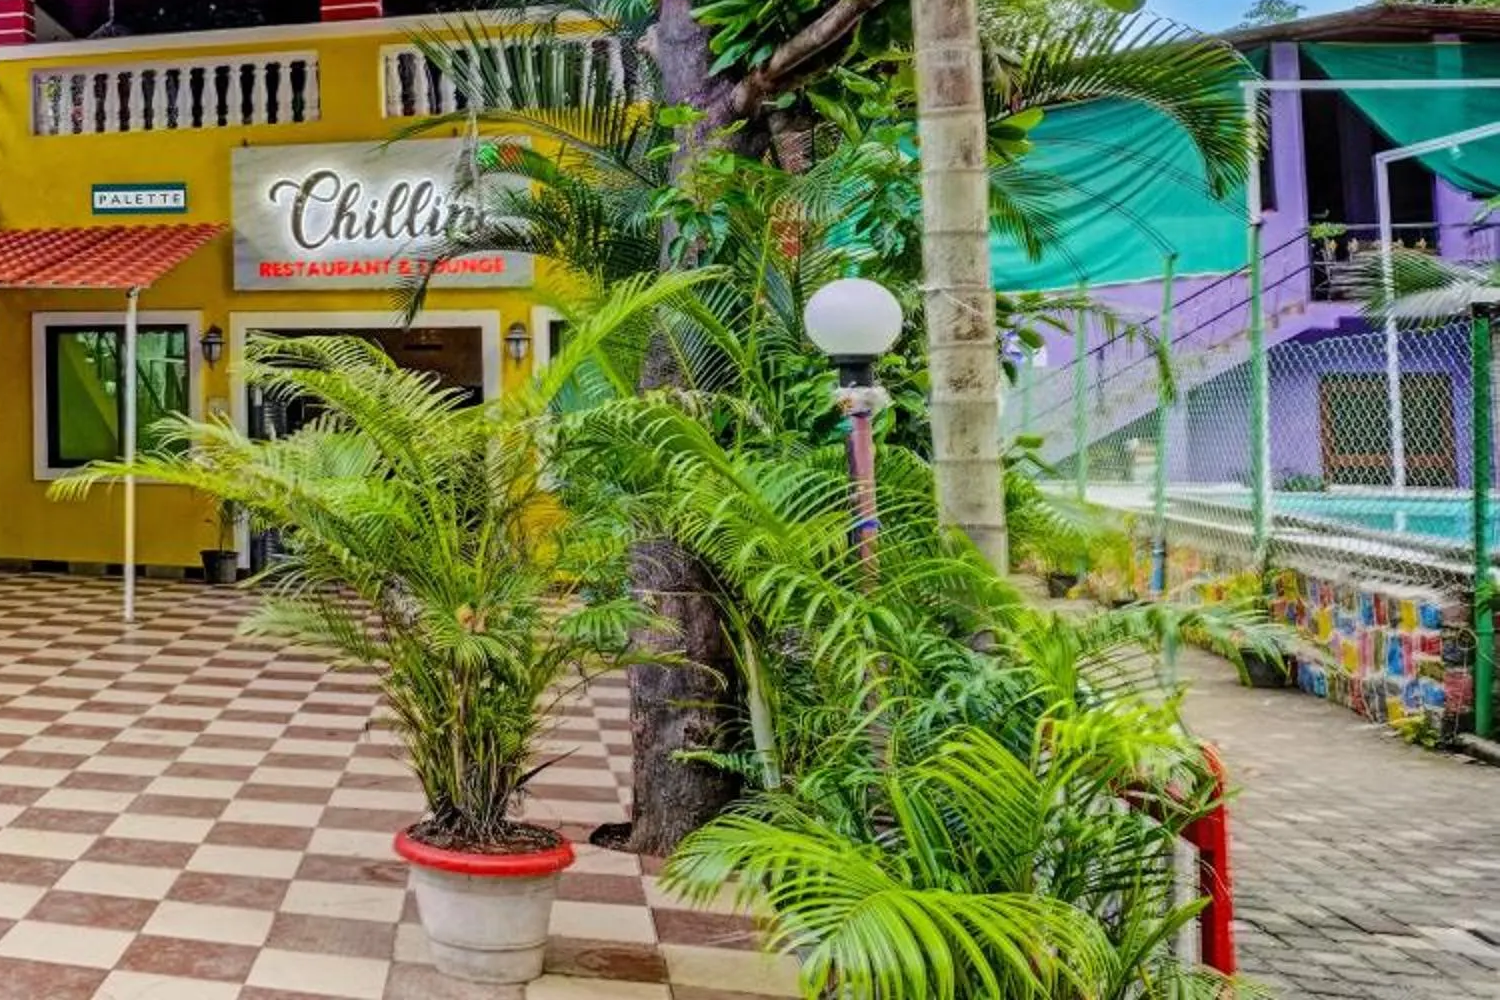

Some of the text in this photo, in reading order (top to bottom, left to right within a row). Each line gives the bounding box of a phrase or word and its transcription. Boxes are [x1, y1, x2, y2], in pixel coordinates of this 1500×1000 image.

[98, 193, 182, 205] PALETTE
[259, 258, 391, 277] RESTAURANT
[397, 258, 412, 277] &
